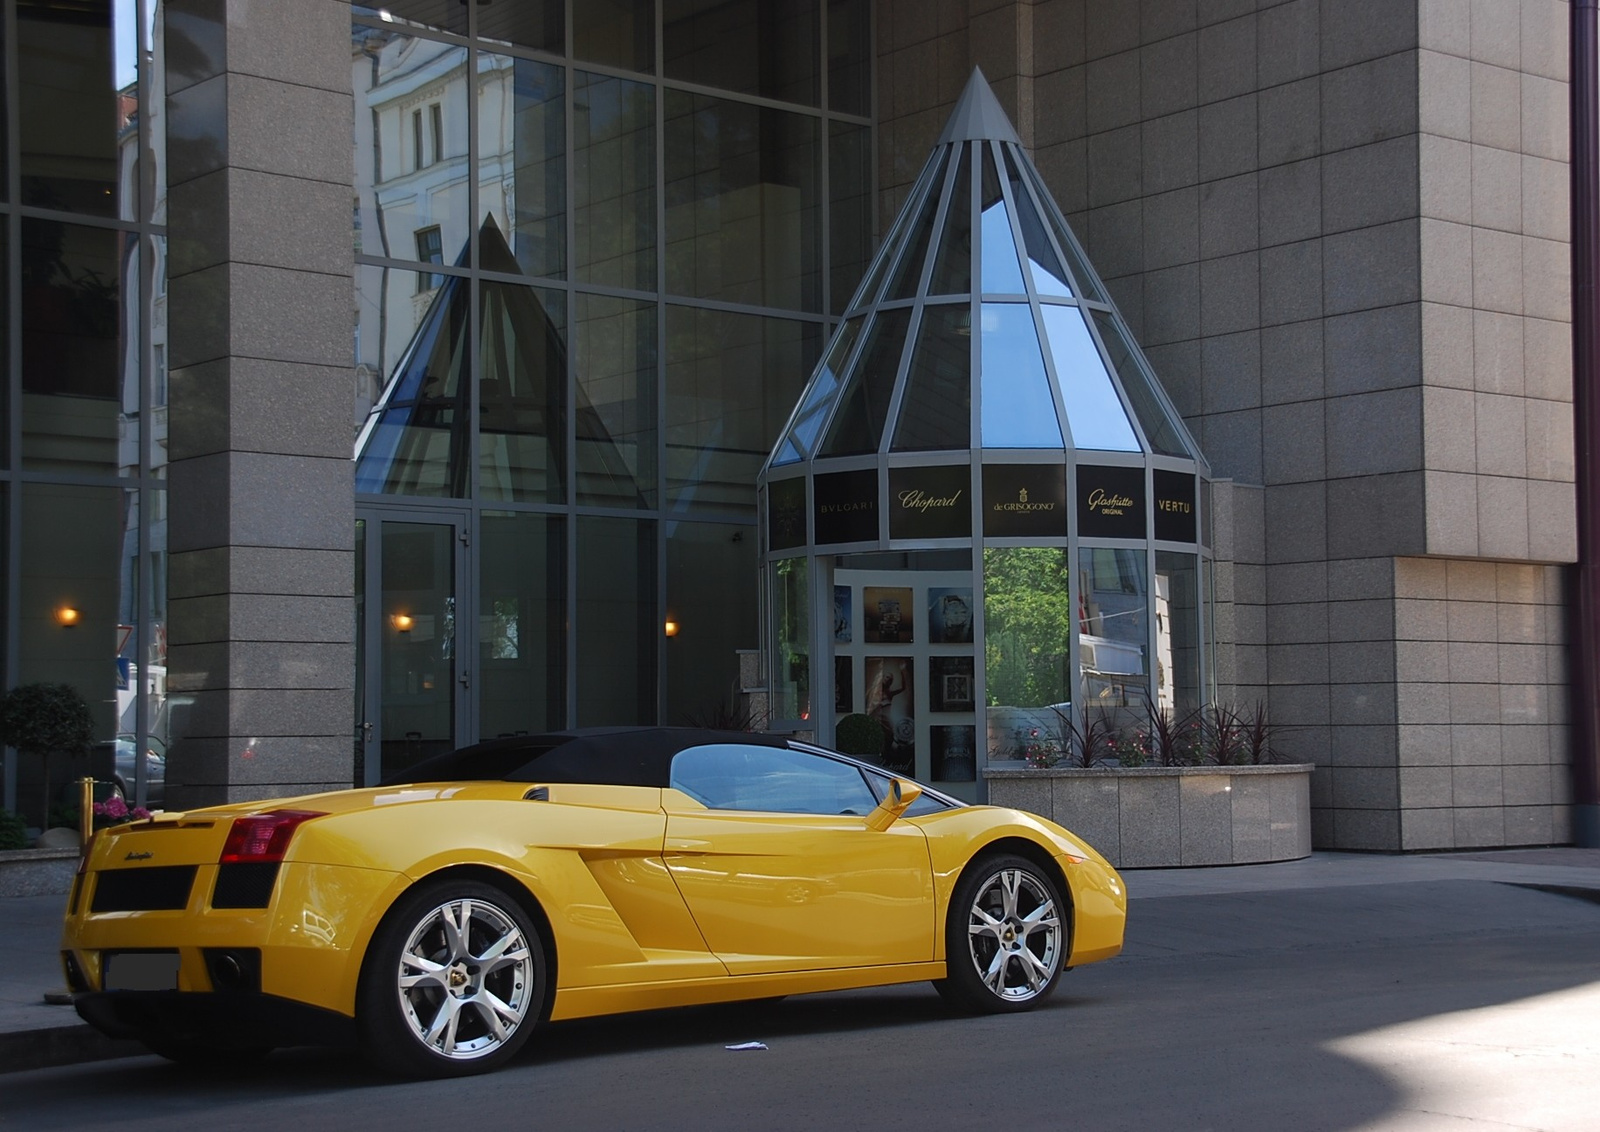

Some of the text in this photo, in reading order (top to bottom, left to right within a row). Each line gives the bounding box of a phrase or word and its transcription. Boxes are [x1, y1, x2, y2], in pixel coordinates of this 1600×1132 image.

[820, 501, 873, 513] BVLGARI
[898, 490, 961, 513] Chopard
[993, 502, 1054, 511] de GRISOGONO
[1159, 499, 1190, 514] VERTU
[1101, 508, 1124, 516] ORIGINAL
